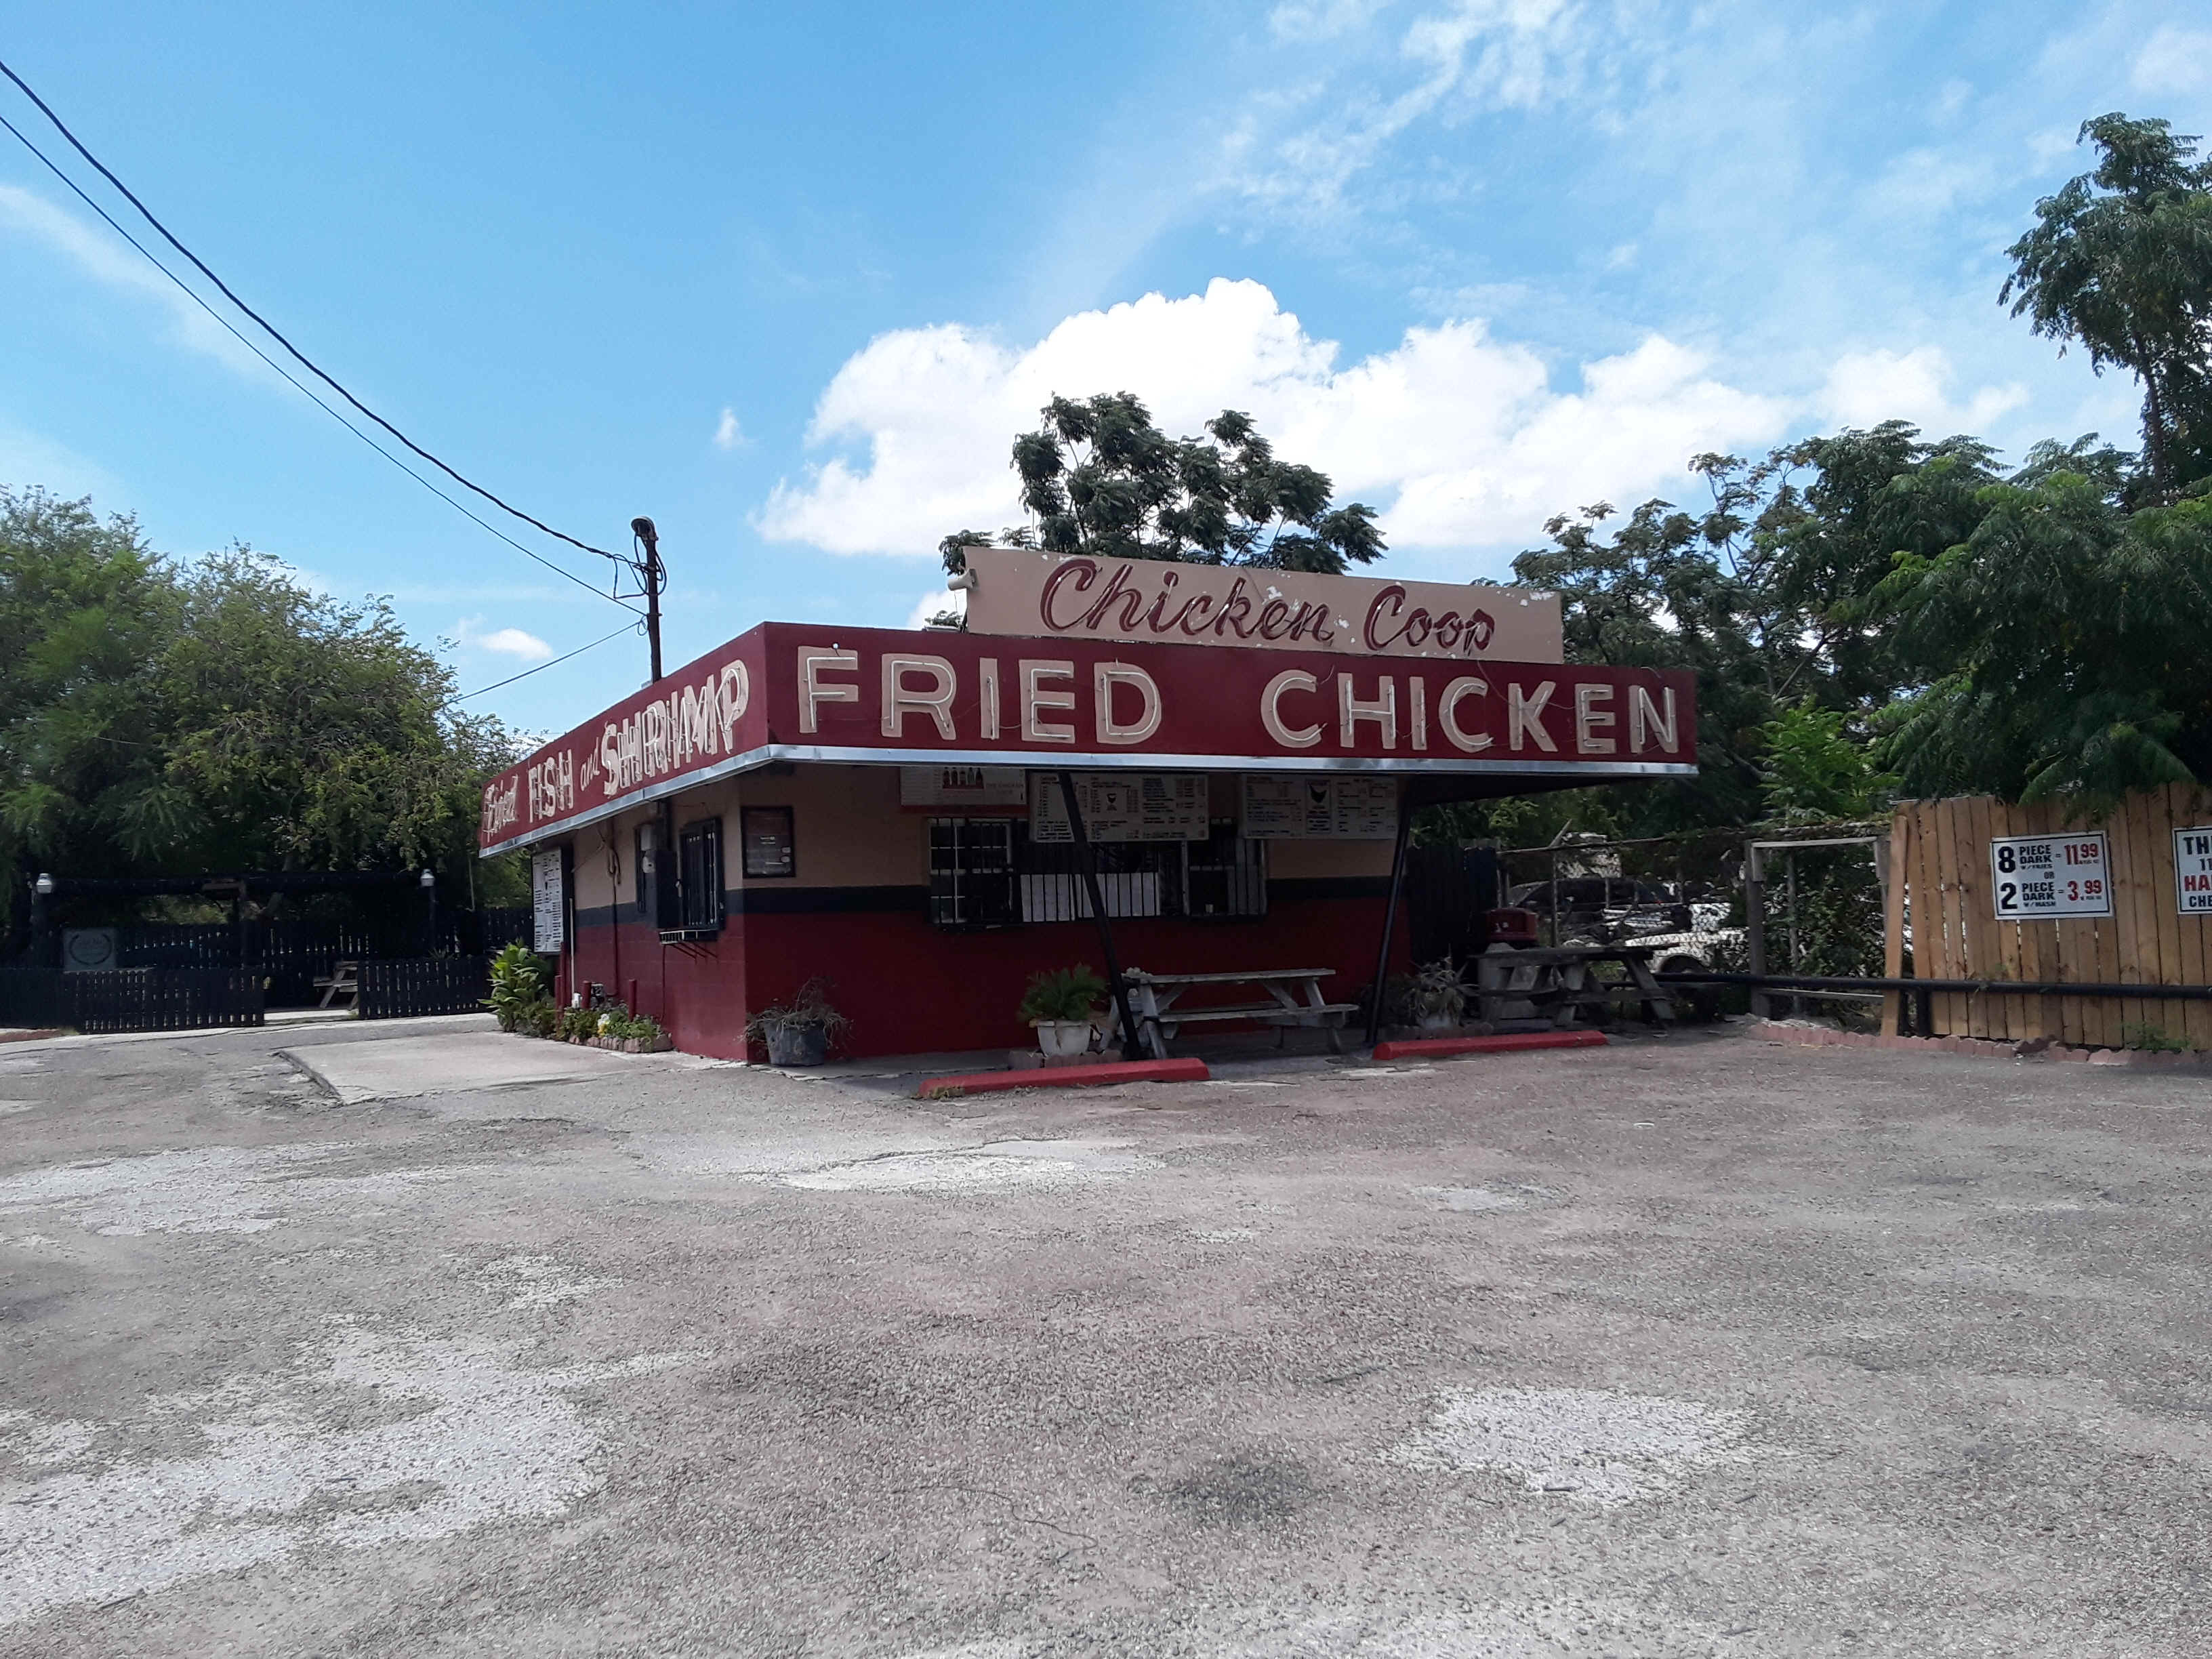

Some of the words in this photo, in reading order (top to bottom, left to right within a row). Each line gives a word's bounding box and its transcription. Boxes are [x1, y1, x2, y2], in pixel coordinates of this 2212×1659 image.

[1040, 558, 1334, 642] Chicken
[1364, 584, 1495, 653] Coop
[798, 645, 1162, 745] FRIED
[1260, 669, 1679, 755] CHICKEN
[528, 748, 573, 823] FISH
[601, 659, 750, 797] SHRIMP
[1999, 846, 2016, 873] 8
[2020, 844, 2051, 856] PIECE
[2184, 836, 2212, 855] TH
[2020, 855, 2052, 865] DARK
[2001, 882, 2018, 909] 2
[2022, 882, 2054, 893] PIECE
[2184, 875, 2212, 891] HA
[2022, 893, 2055, 901] DARK
